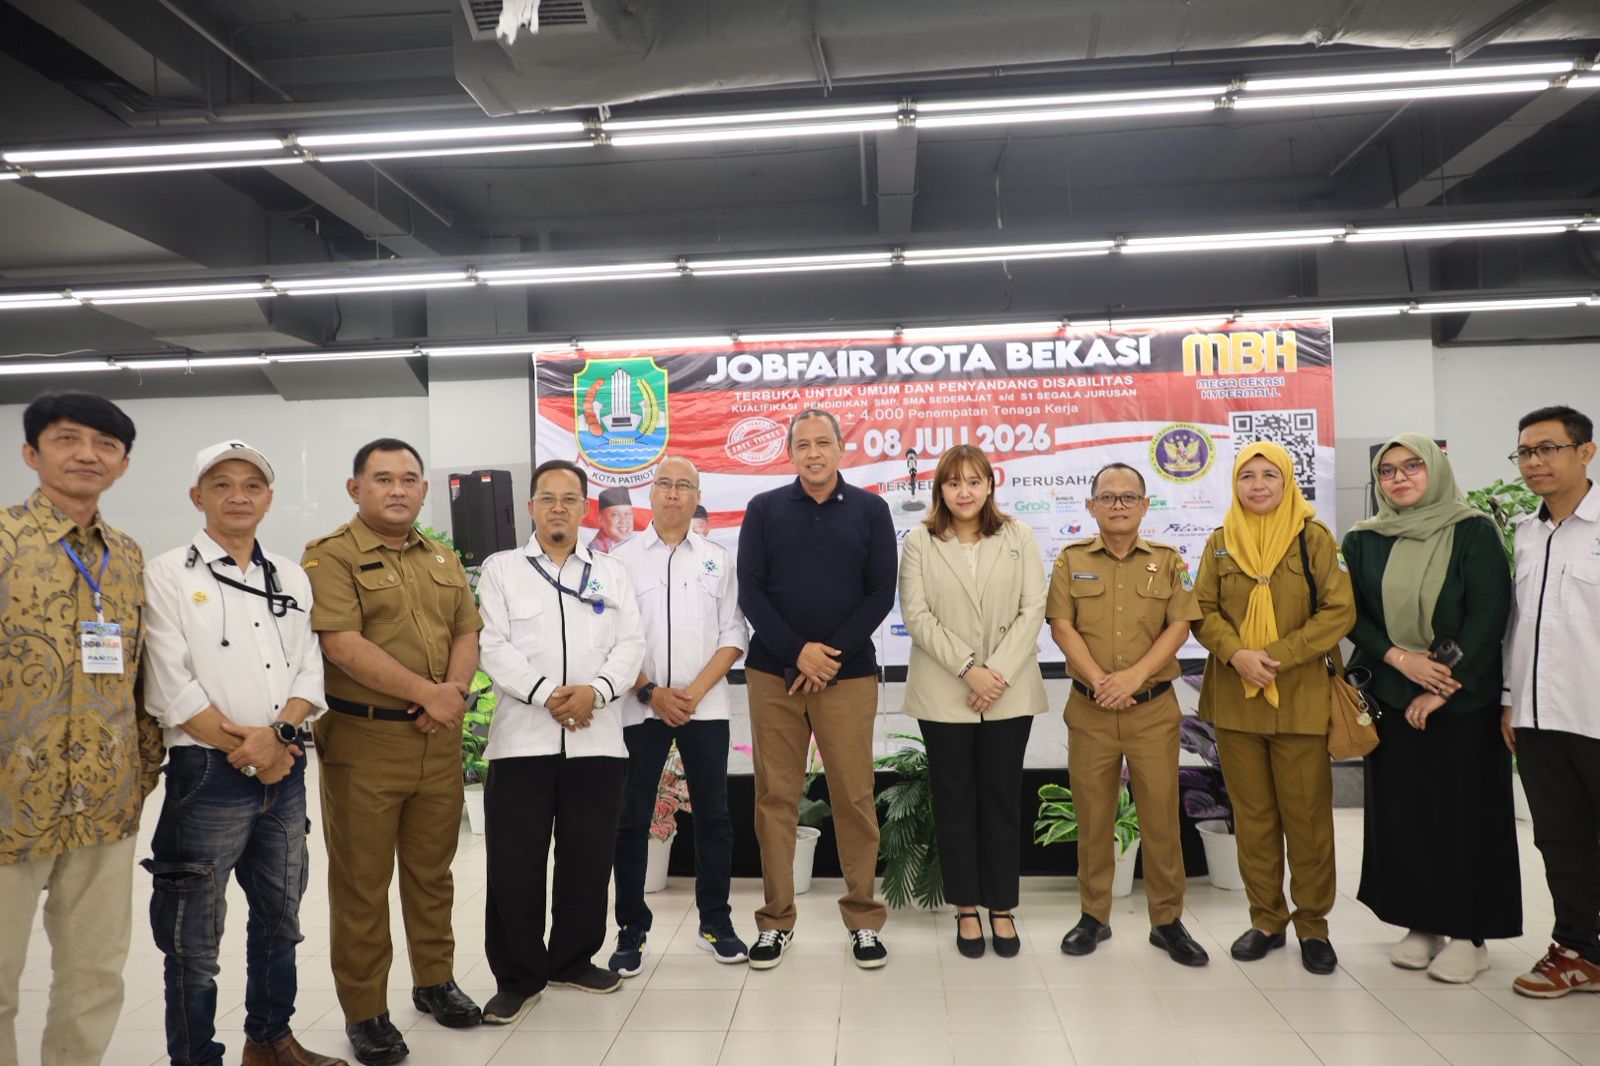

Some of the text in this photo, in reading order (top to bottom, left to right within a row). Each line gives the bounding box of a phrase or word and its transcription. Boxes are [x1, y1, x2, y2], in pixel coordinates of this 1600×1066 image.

[705, 336, 1151, 383] JOBFAIR KOTA BEKASI
[1182, 330, 1298, 376] MBH
[734, 375, 1133, 401] TERBUKA UNTUK UMUM DAN PENYANDANG DISABILITAS
[1197, 376, 1285, 388] MEGA BEKASI
[731, 403, 798, 413] KUALIFIKASI
[803, 400, 868, 411] PENDIDIKAN
[903, 397, 926, 405] SMA
[928, 394, 992, 404] SEDERAJAT
[1020, 392, 1033, 401] S1
[1037, 391, 1081, 400] SEGALA
[1084, 389, 1137, 398] JURUSAN
[1202, 387, 1280, 399] HYPERMALL
[860, 408, 904, 420] 4.000
[908, 408, 988, 420] Penempatan
[993, 405, 1041, 416] Tenaga
[1045, 403, 1079, 415] Kerja
[863, 428, 902, 457] 08
[975, 423, 1051, 453] 2026
[592, 469, 654, 484] KOTA PATRIOT
[1014, 500, 1050, 512] Grab
